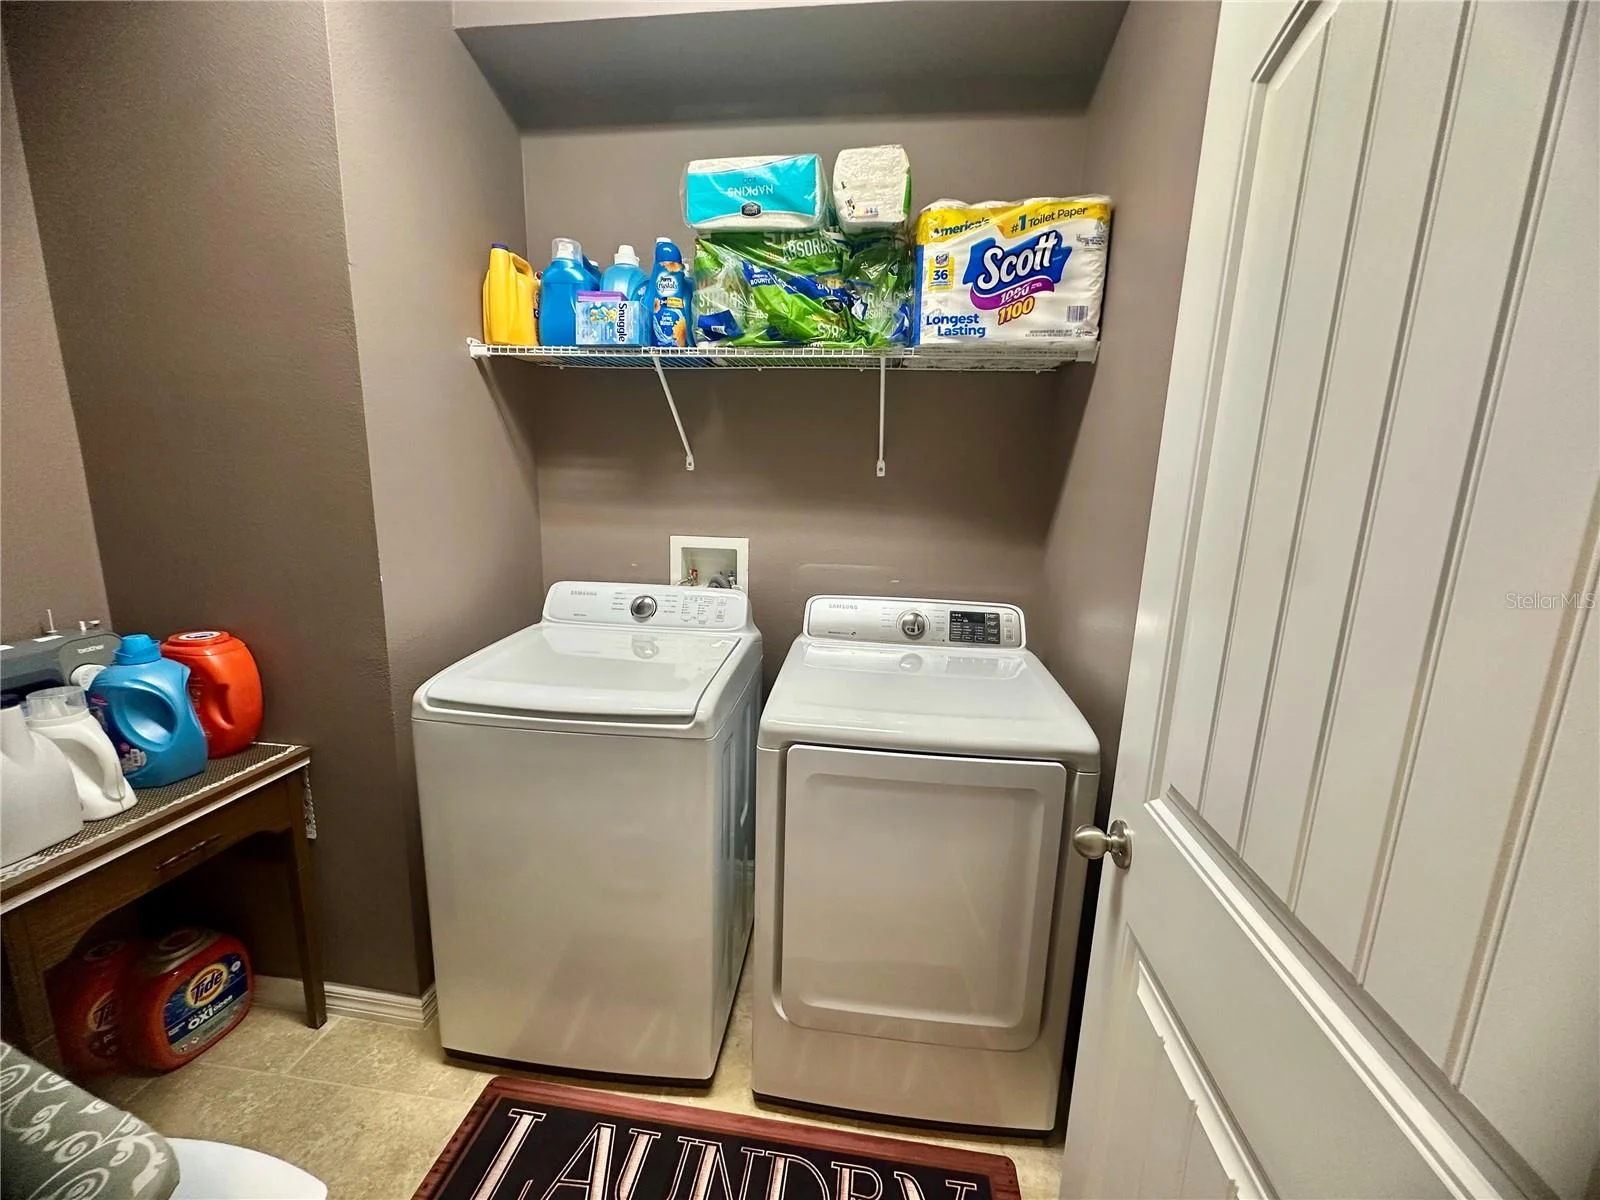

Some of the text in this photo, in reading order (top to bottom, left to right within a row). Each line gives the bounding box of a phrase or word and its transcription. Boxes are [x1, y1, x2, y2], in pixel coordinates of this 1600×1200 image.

[727, 184, 774, 198] NAPKINS
[930, 207, 1088, 237] America's #1 Toilet Paper
[782, 237, 841, 261] ABSORBEN
[977, 235, 1058, 290] Scott
[933, 270, 948, 281] 36
[617, 303, 628, 343] Snuggle
[926, 313, 979, 330] Longest
[998, 296, 1035, 325] 1100
[938, 325, 986, 338] Lasting
[190, 970, 224, 1005] Tide
[469, 1108, 978, 1200] LAUNDR
